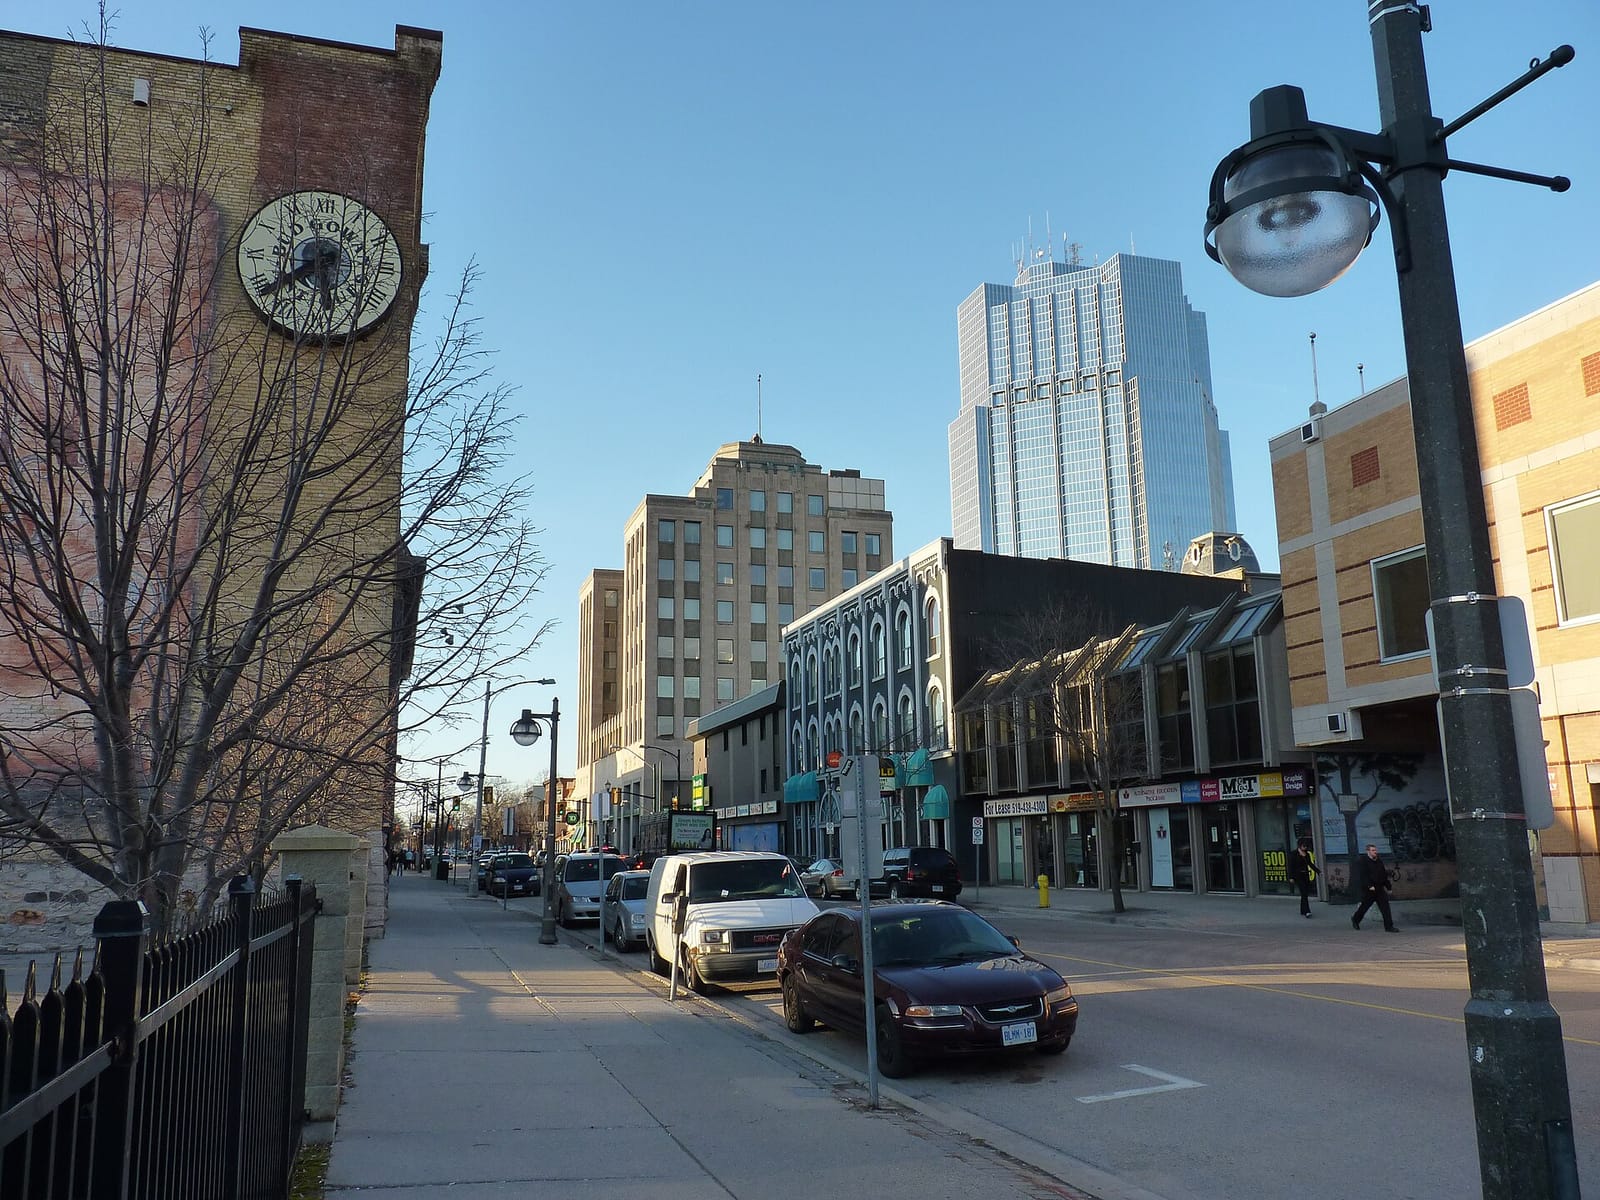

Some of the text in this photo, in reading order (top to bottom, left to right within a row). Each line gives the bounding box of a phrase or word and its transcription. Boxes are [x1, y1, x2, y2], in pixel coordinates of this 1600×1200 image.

[317, 199, 334, 214] XII
[1221, 777, 1257, 795] M&T
[985, 802, 994, 815] For
[995, 802, 1011, 815] Lease
[1264, 852, 1285, 866] 500
